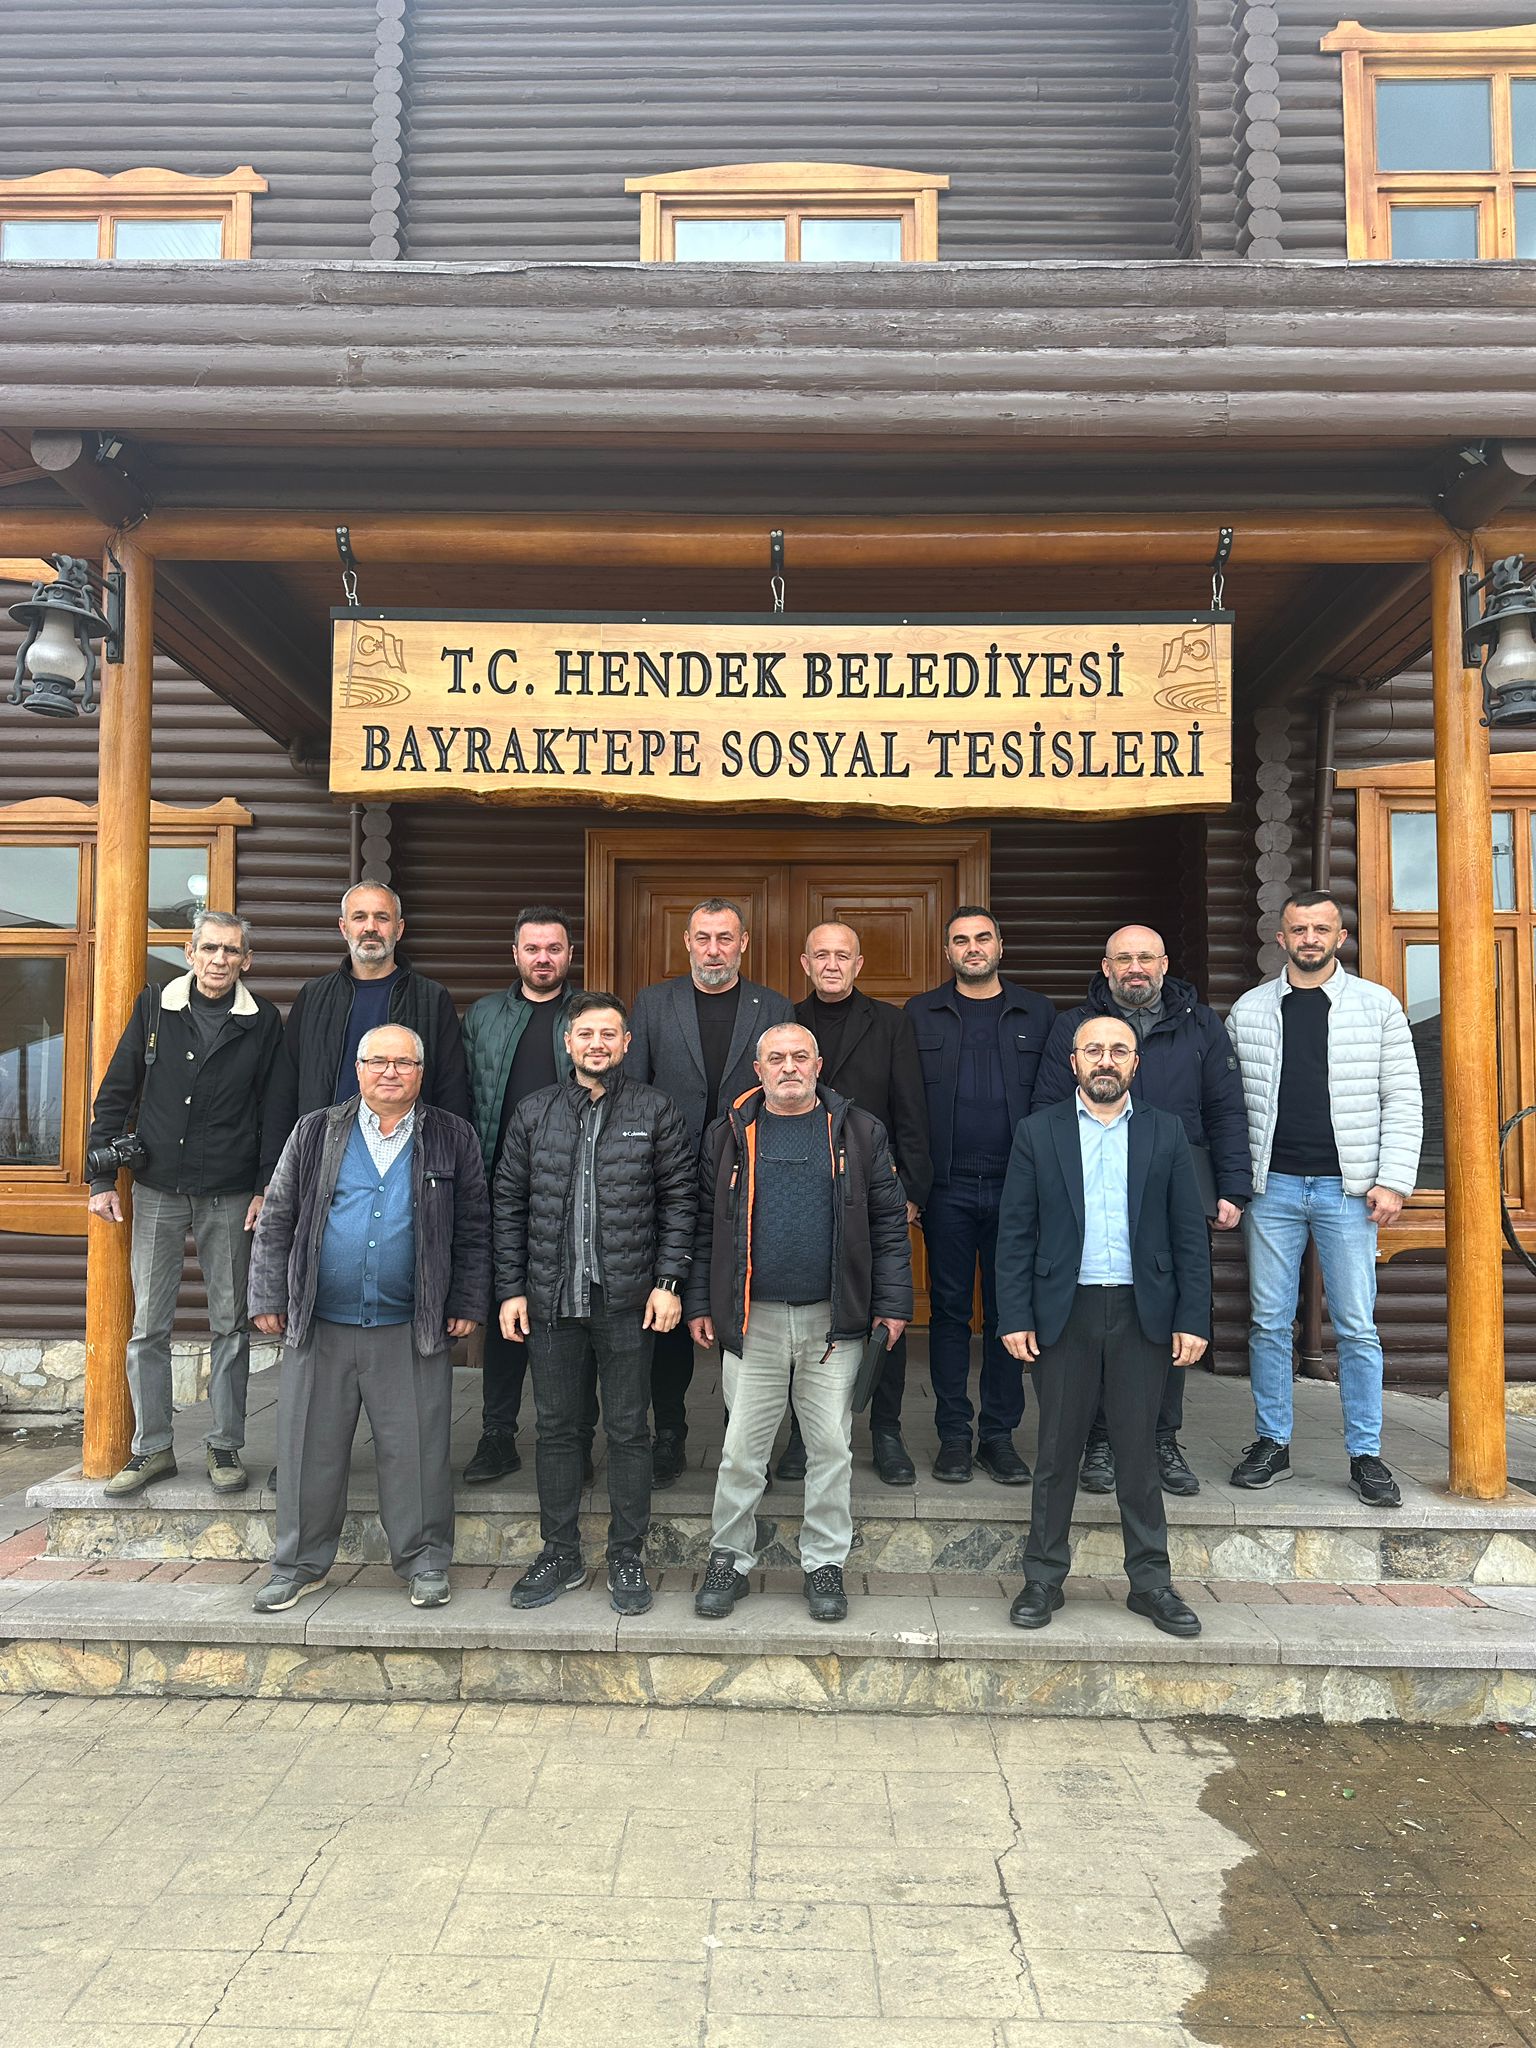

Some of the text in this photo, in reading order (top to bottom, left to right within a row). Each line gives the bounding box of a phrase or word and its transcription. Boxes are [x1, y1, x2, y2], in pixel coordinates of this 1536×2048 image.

[440, 643, 1125, 698] T.C. HENDEK BELEDİYESİ
[361, 721, 1204, 778] BAYRAKTEPE SOSYAL TESİSLERİ
